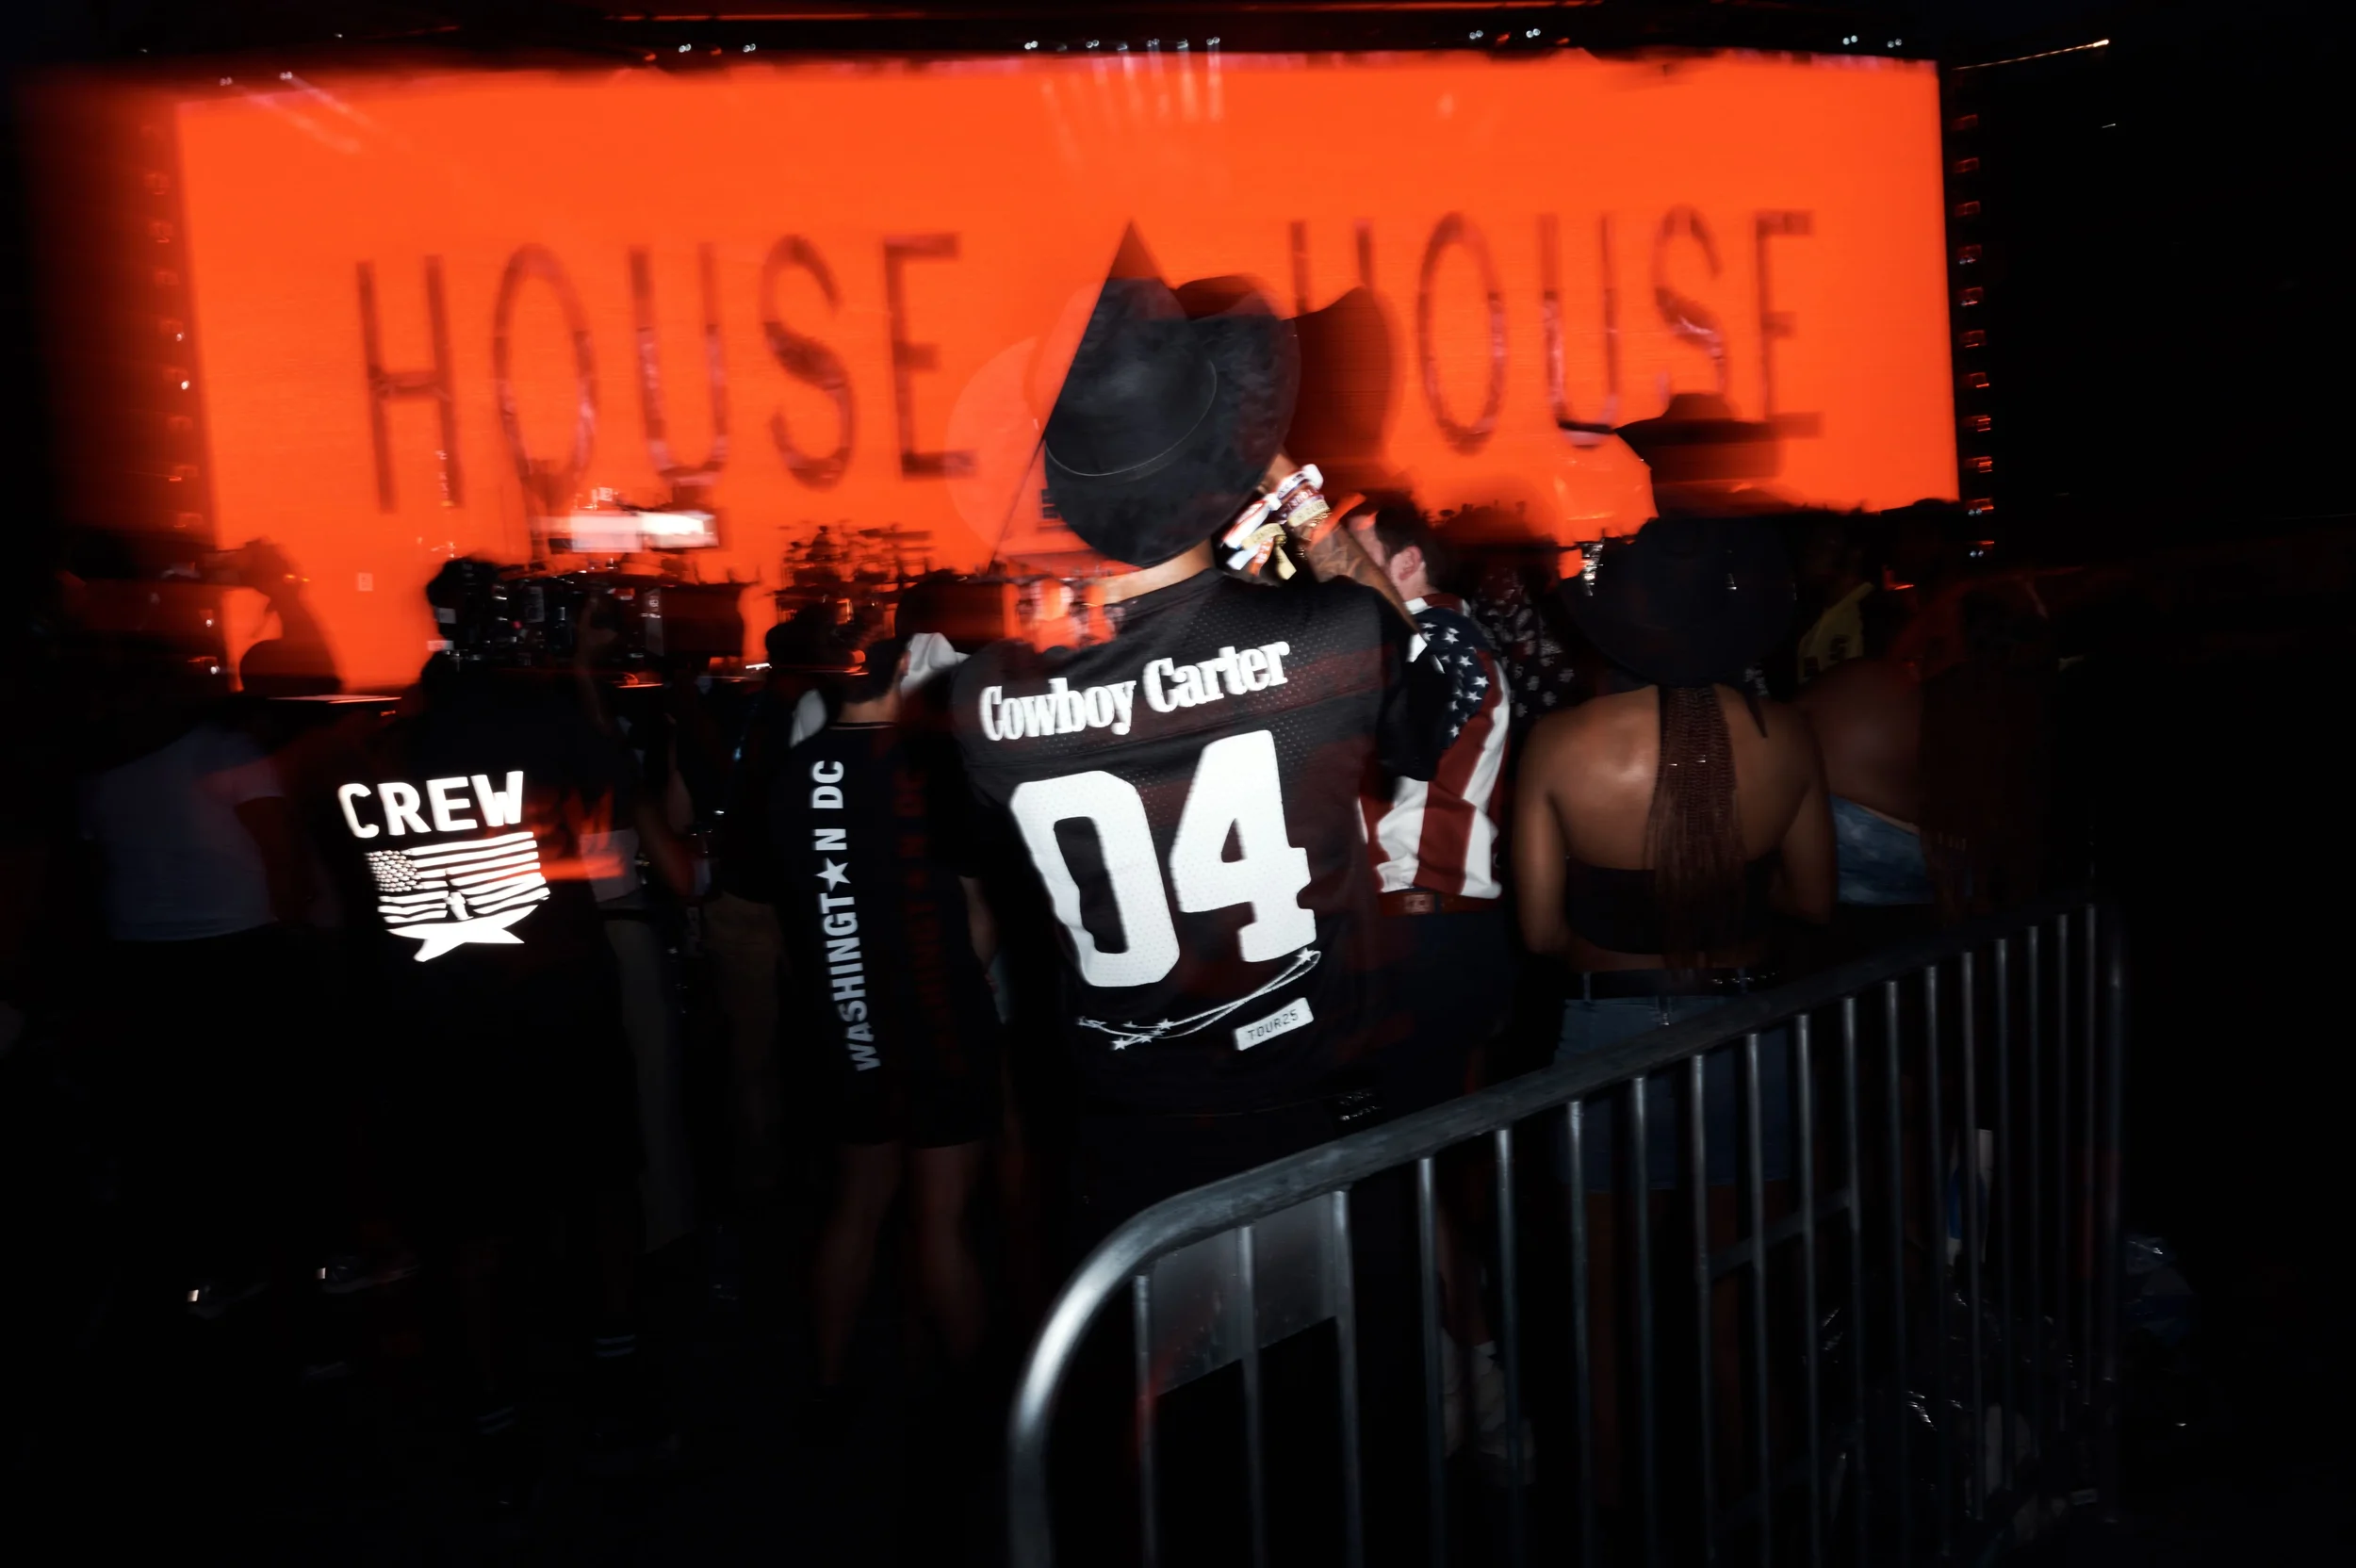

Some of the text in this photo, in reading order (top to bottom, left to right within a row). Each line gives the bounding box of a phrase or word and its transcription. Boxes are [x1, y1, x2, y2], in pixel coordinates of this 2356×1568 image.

[354, 232, 978, 512] HOUSE
[979, 641, 1290, 742] Cowboy Carter
[337, 771, 524, 839] CREW
[1009, 729, 1317, 988] 04
[811, 760, 881, 1071] WASHINGTN DC
[1247, 1009, 1300, 1040] TOUR25
